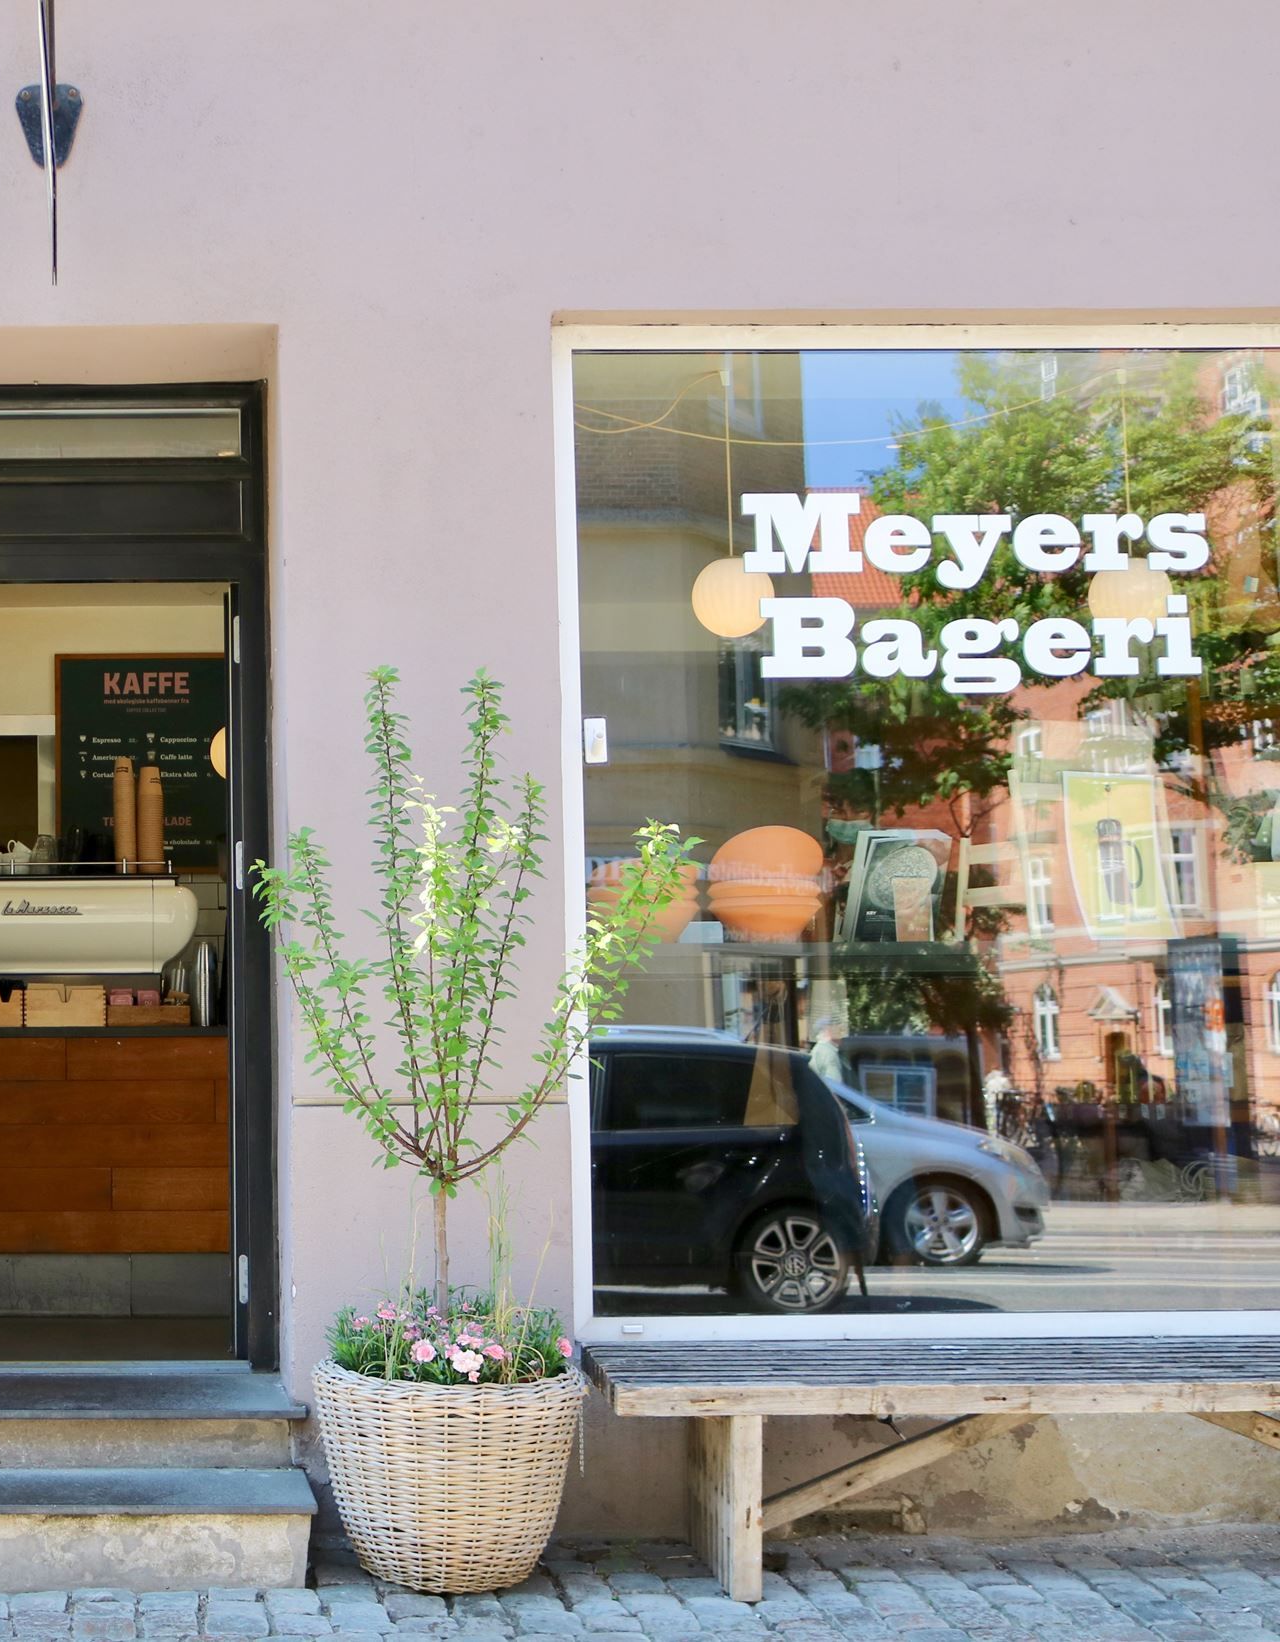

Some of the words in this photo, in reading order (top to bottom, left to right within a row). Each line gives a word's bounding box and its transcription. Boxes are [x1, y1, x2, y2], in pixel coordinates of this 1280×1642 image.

[740, 492, 1211, 590] Meyers
[758, 594, 1203, 695] Bageri
[104, 672, 190, 694] KAFFE
[92, 736, 122, 744] Espresso
